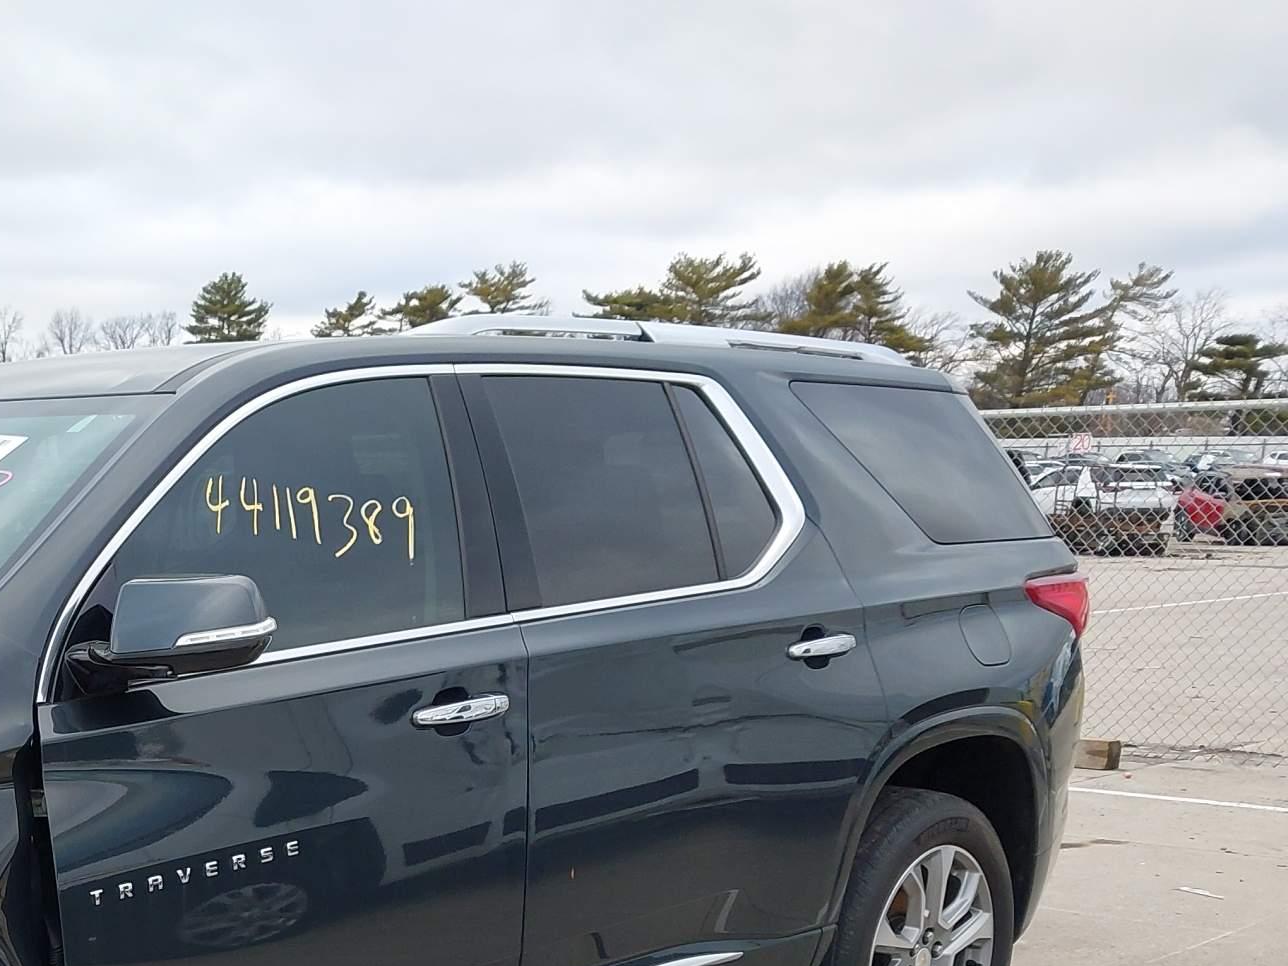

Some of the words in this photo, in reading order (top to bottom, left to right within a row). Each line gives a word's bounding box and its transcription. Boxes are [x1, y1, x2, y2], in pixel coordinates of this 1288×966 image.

[1073, 433, 1091, 450] 20
[205, 474, 415, 560] 44119389
[89, 840, 299, 906] TRAVERSE
